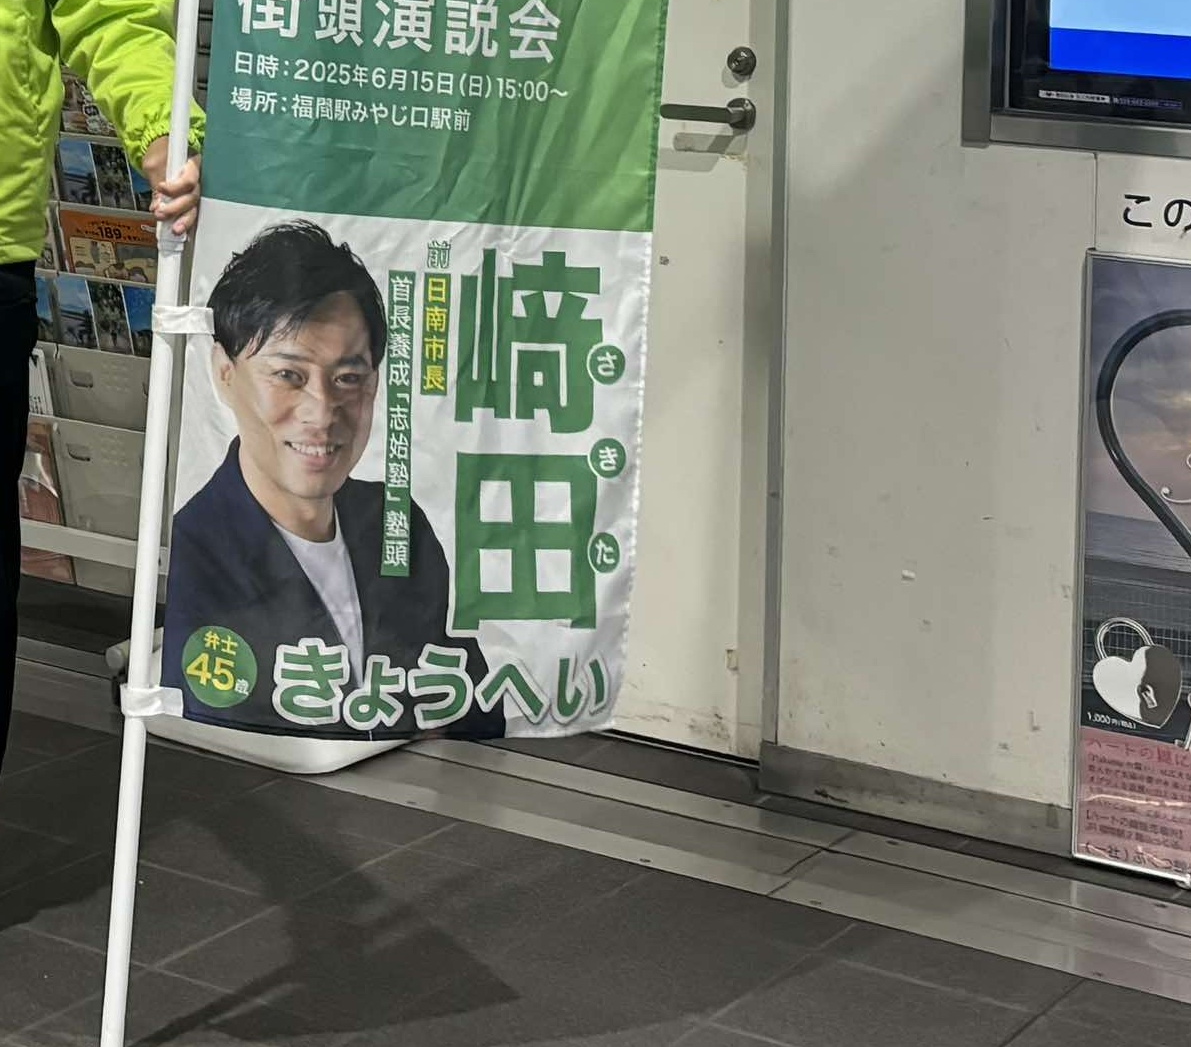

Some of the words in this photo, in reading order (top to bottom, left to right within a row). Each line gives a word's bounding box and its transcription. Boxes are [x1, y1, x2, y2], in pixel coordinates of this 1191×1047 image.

[203, 630, 239, 655] 弁士
[278, 643, 607, 726] きょうへい
